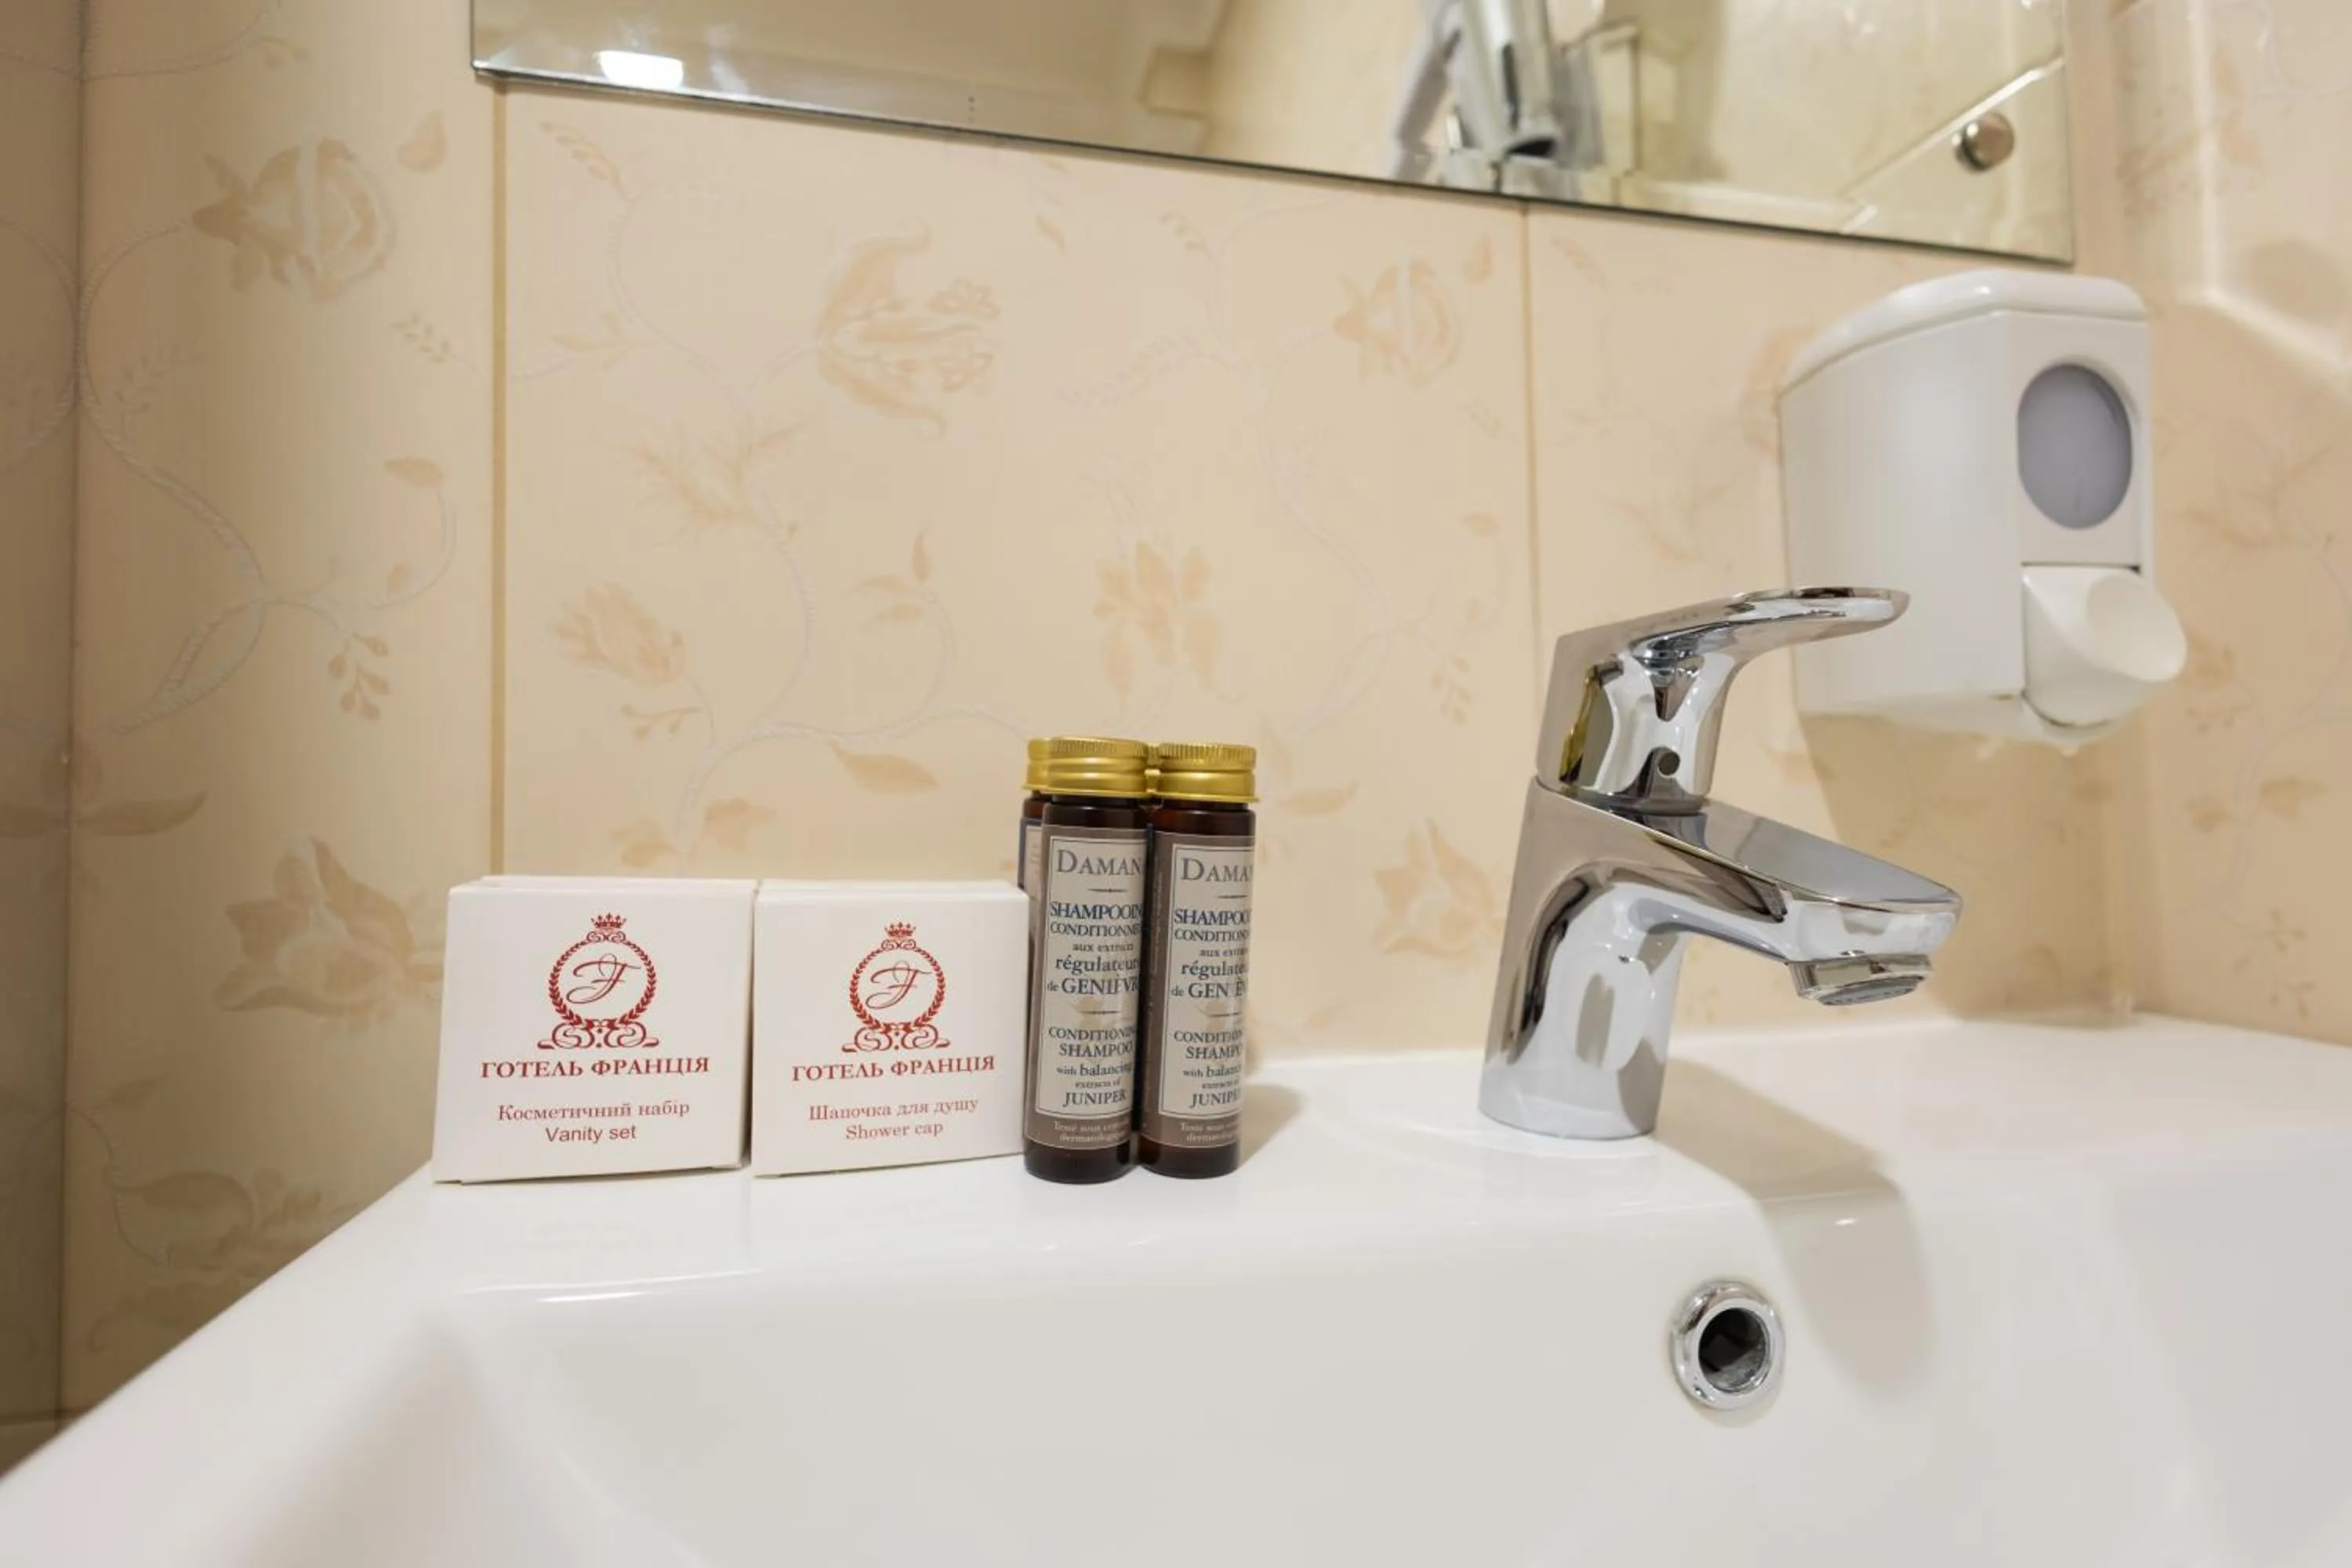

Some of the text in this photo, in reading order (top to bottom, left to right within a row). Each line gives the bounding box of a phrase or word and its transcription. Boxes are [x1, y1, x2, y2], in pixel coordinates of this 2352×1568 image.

[1047, 979, 1060, 992] de
[1171, 985, 1185, 996] de
[479, 1056, 710, 1079] ГОТЕЛЬ ФРАНЦІЯ
[792, 1055, 996, 1082] ГОТЕЛЬ ФРАНЦІЯ
[1056, 1066, 1076, 1076] with
[1062, 1089, 1127, 1108] JUNIPER
[496, 1099, 691, 1122] Косметичний набір
[808, 1098, 979, 1121] Шапочка для душу
[545, 1125, 637, 1145] Vanity set
[845, 1123, 944, 1141] Shower cap
